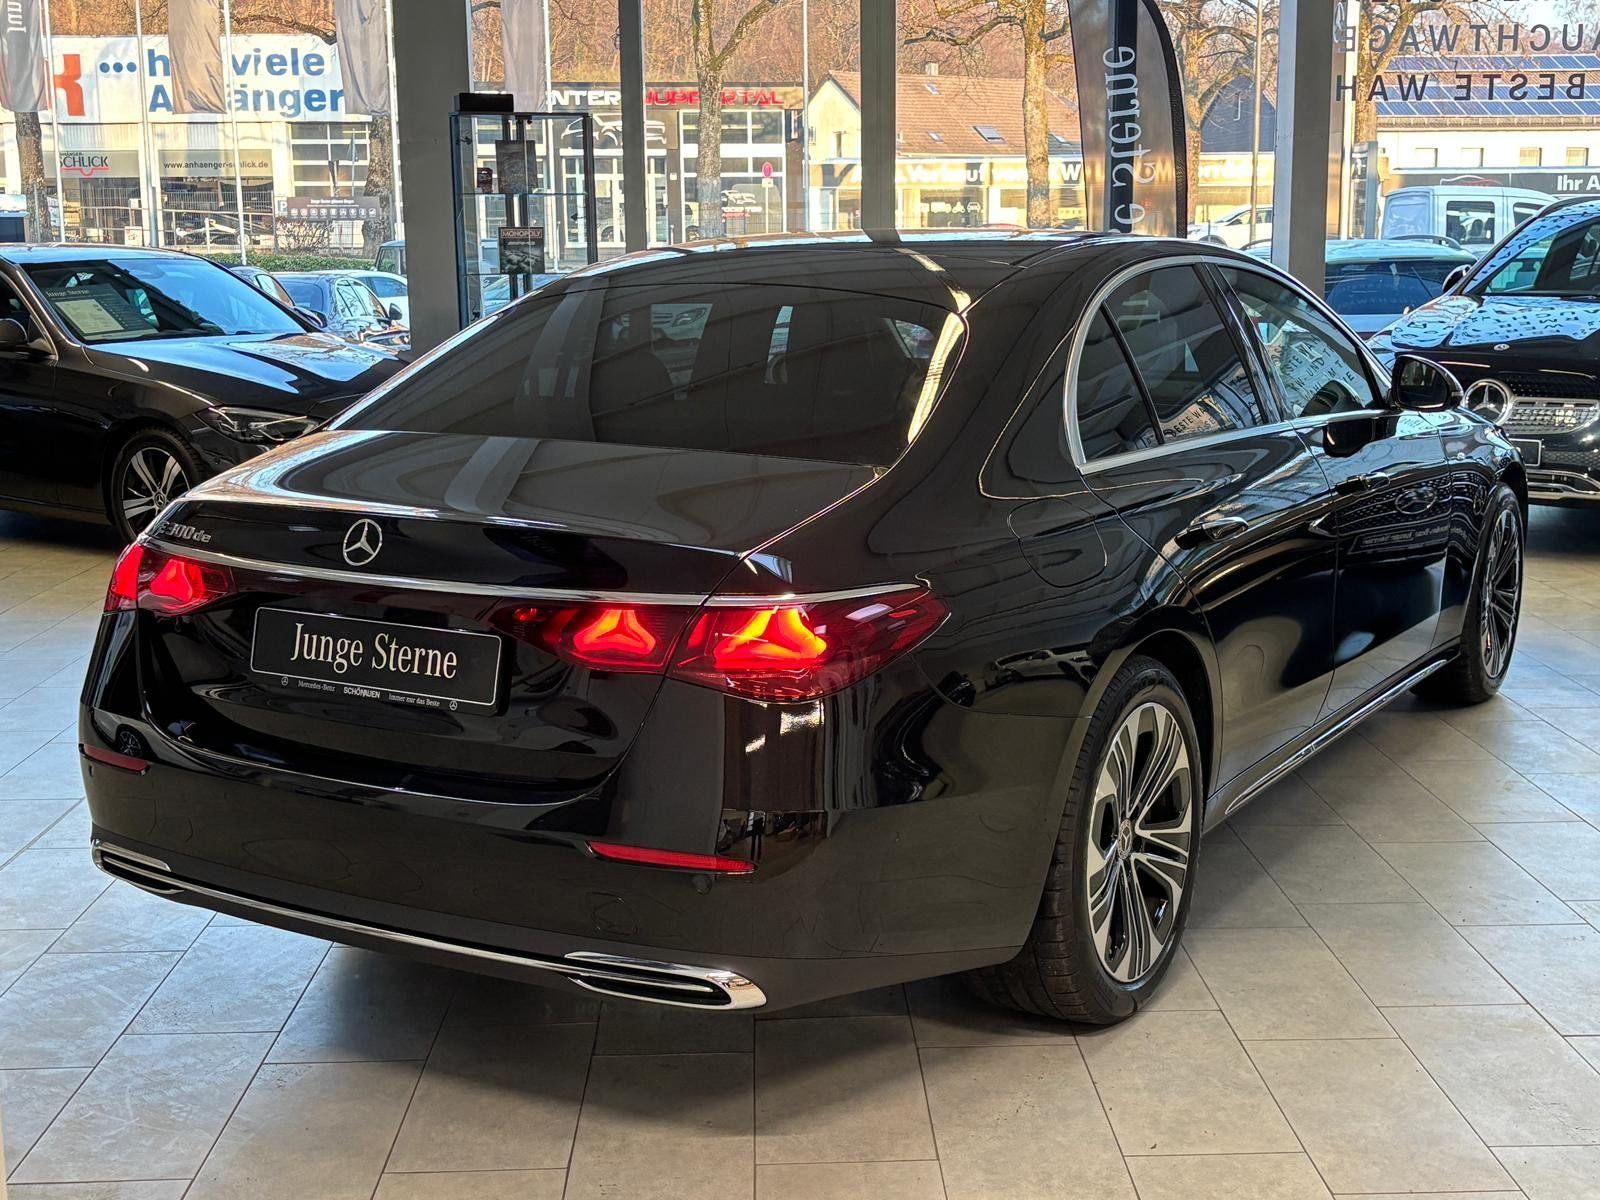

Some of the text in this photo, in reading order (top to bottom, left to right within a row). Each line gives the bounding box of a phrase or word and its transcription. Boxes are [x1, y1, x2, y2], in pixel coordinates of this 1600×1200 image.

[231, 47, 326, 77] viele
[148, 83, 344, 118] Aänger
[1557, 174, 1584, 191] Ihr
[290, 622, 458, 680] Junge Sterne
